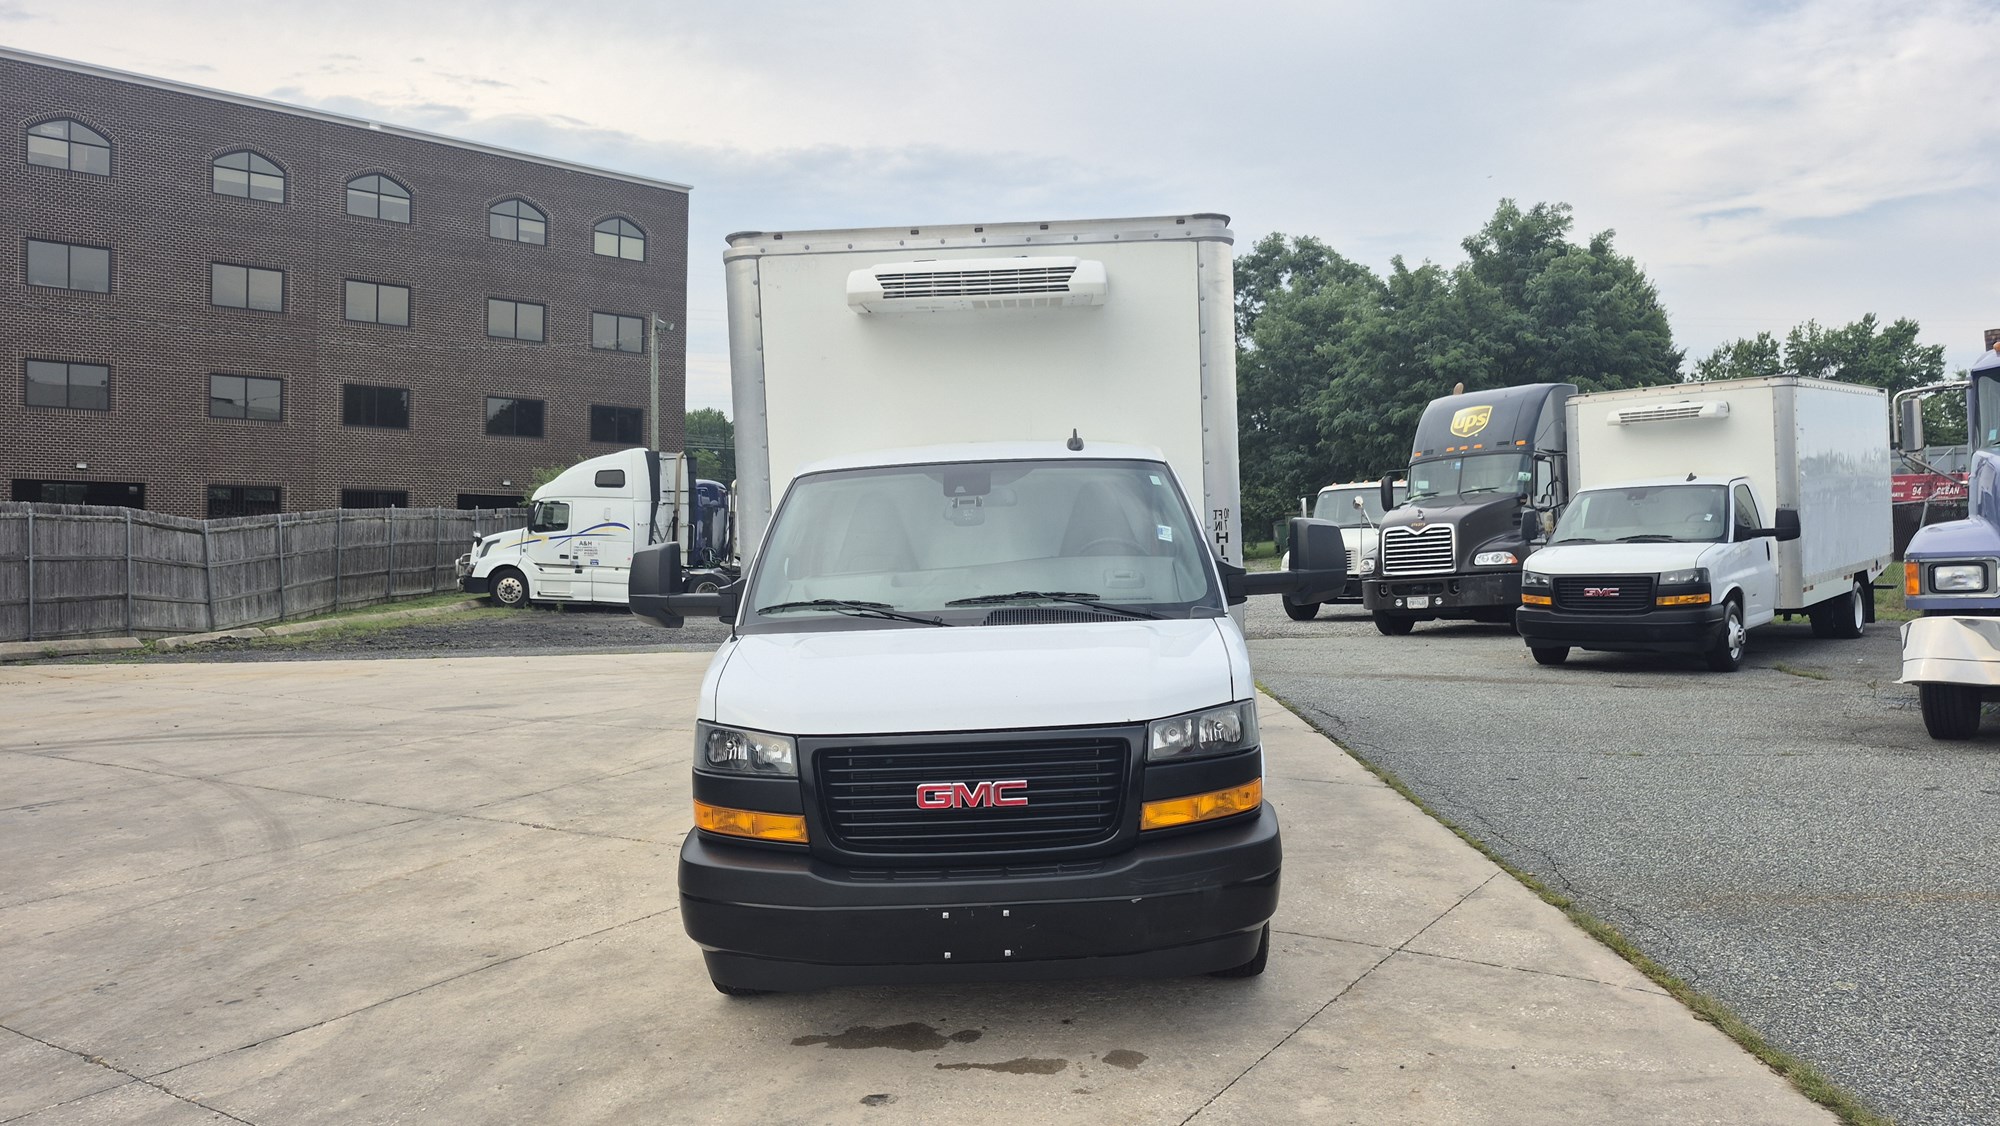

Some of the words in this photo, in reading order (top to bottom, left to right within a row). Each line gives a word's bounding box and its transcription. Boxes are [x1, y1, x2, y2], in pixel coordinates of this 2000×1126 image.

[1454, 413, 1487, 432] ups
[1912, 487, 1922, 496] 94
[1583, 588, 1619, 596] GMC
[917, 780, 1028, 809] GMC
